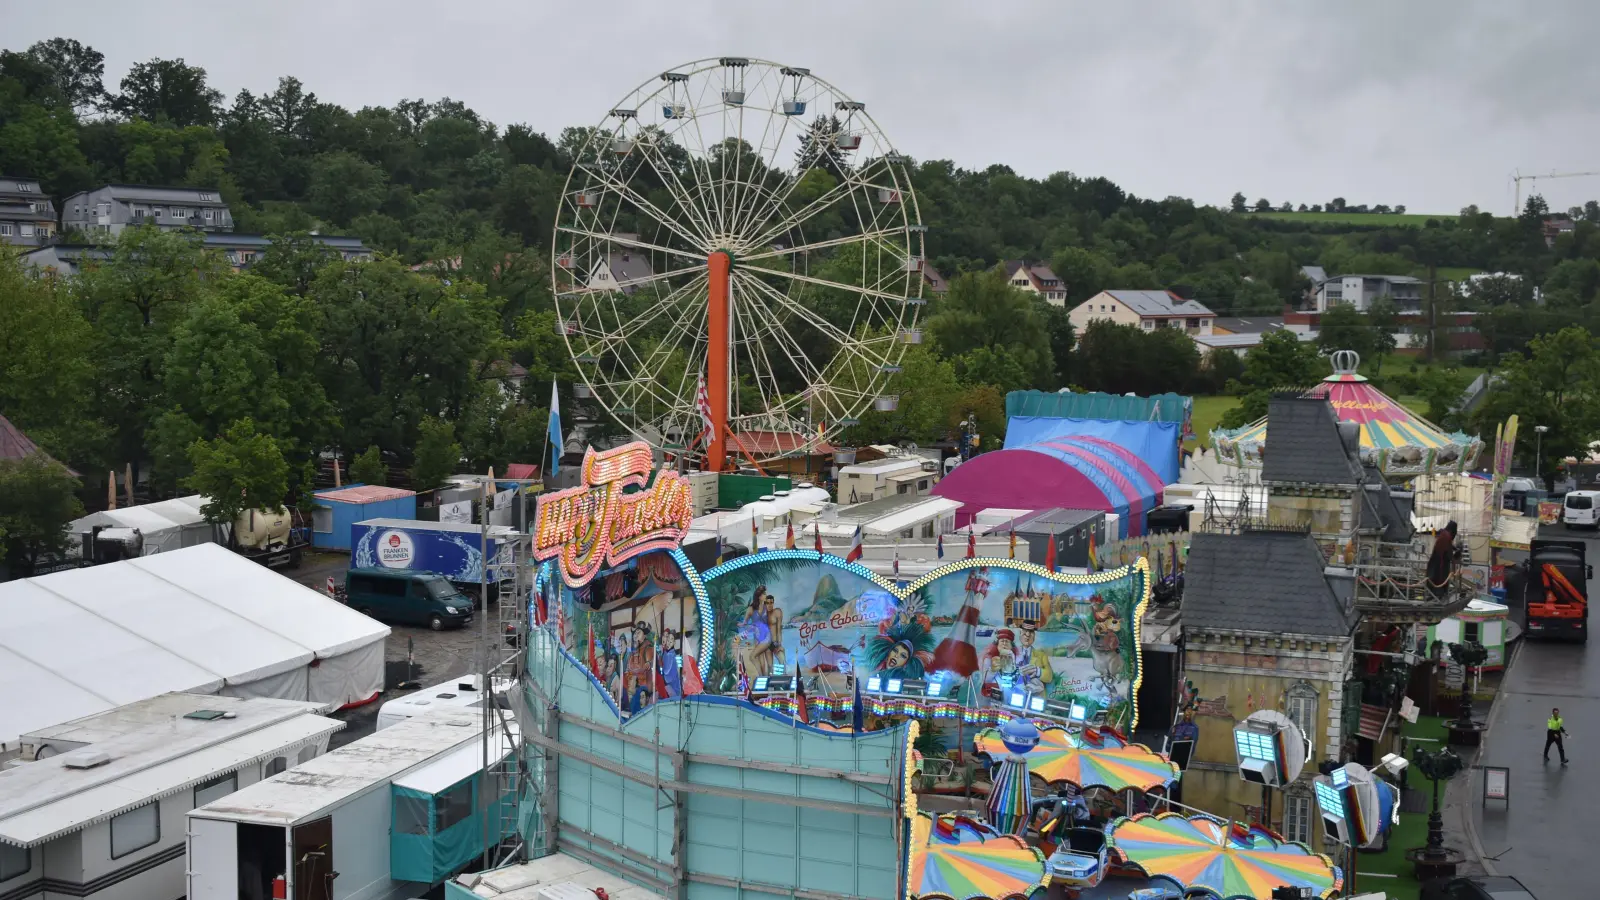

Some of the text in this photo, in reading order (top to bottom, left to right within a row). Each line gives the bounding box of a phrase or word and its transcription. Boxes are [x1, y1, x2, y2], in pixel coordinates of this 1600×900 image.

[383, 552, 409, 560] BRUNNEN
[799, 611, 877, 639] Copa Cabana
